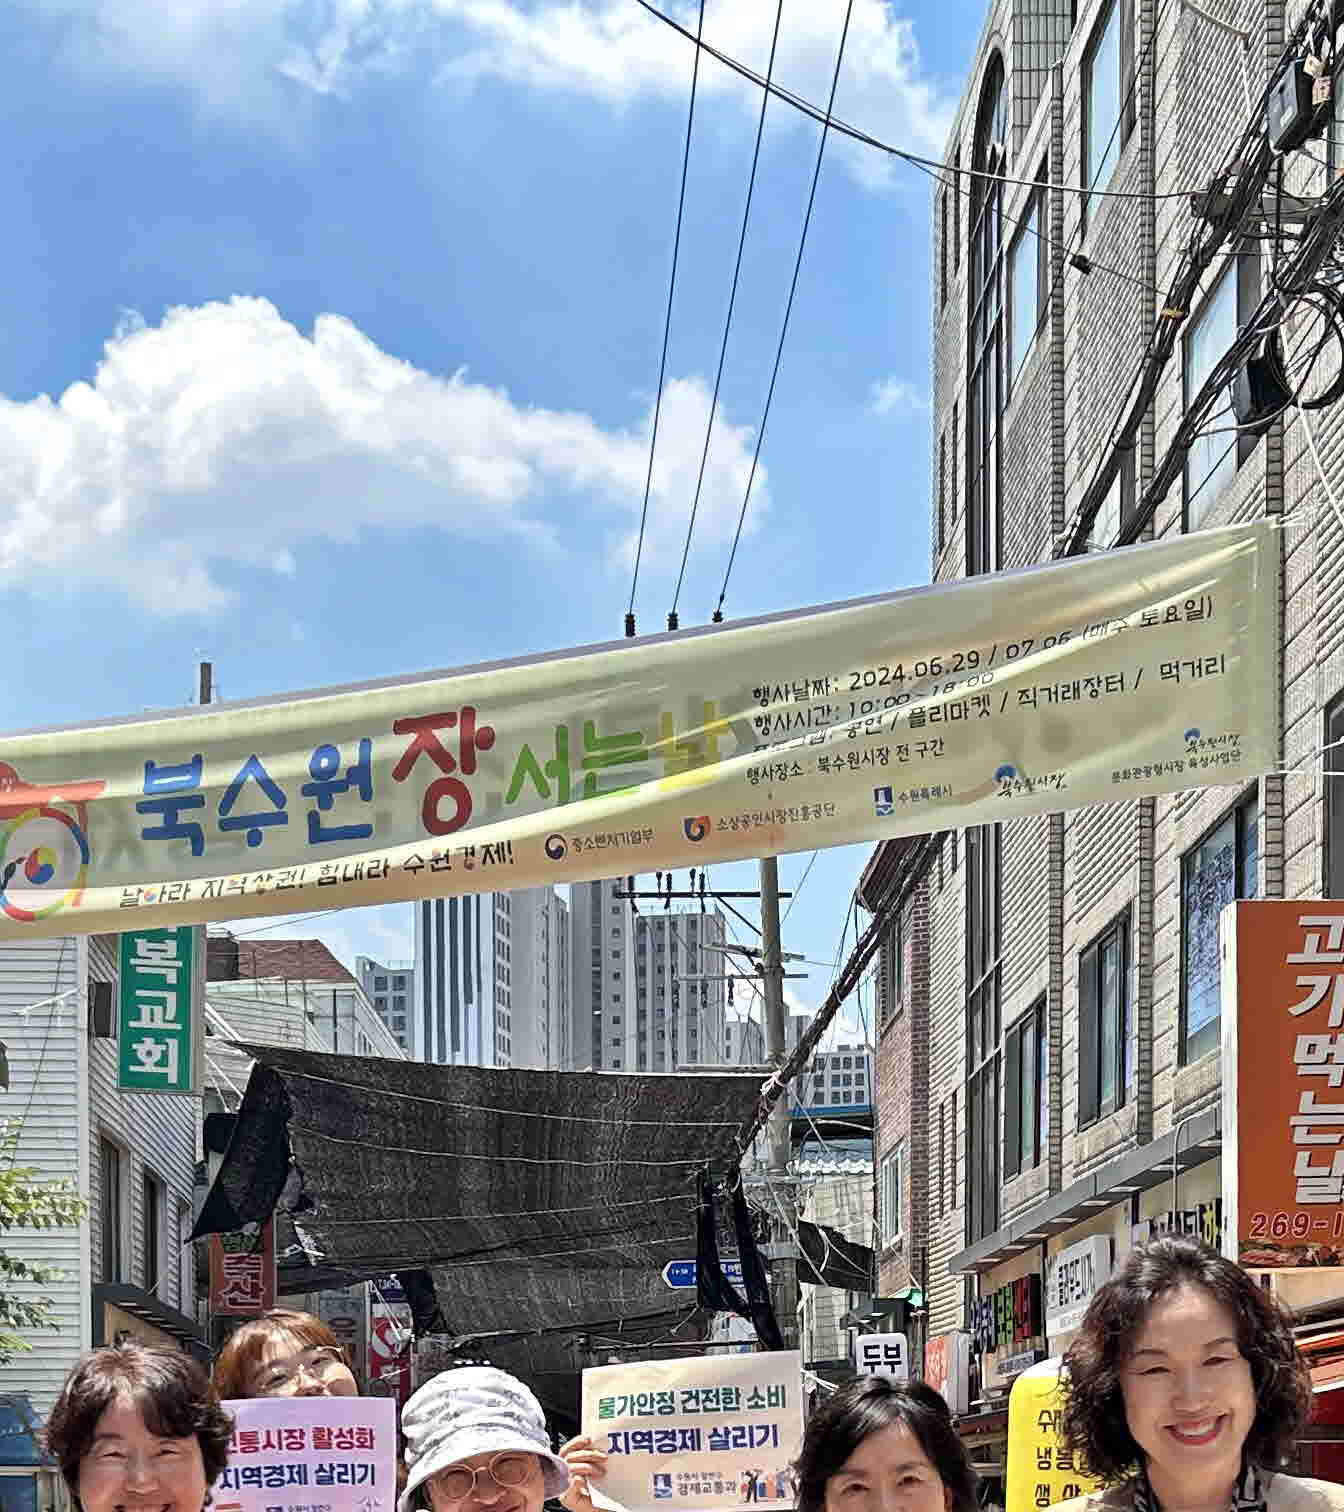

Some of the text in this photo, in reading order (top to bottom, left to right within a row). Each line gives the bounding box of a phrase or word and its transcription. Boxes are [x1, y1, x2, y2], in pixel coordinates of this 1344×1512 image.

[849, 652, 980, 692] 2024.06.29
[908, 691, 991, 728] 플리마켓
[1016, 673, 1125, 709] 직거래장터
[1159, 654, 1227, 688] 먹거리
[816, 745, 891, 774] 북수원시장
[135, 735, 374, 858] 북수원
[863, 1343, 902, 1374] 두부
[598, 1383, 786, 1421] 물가안정 건전한 소비
[311, 1425, 376, 1450] 활성화
[608, 1423, 778, 1455] 지역경제 살리기
[219, 1463, 376, 1490] 지역경제 살리기
